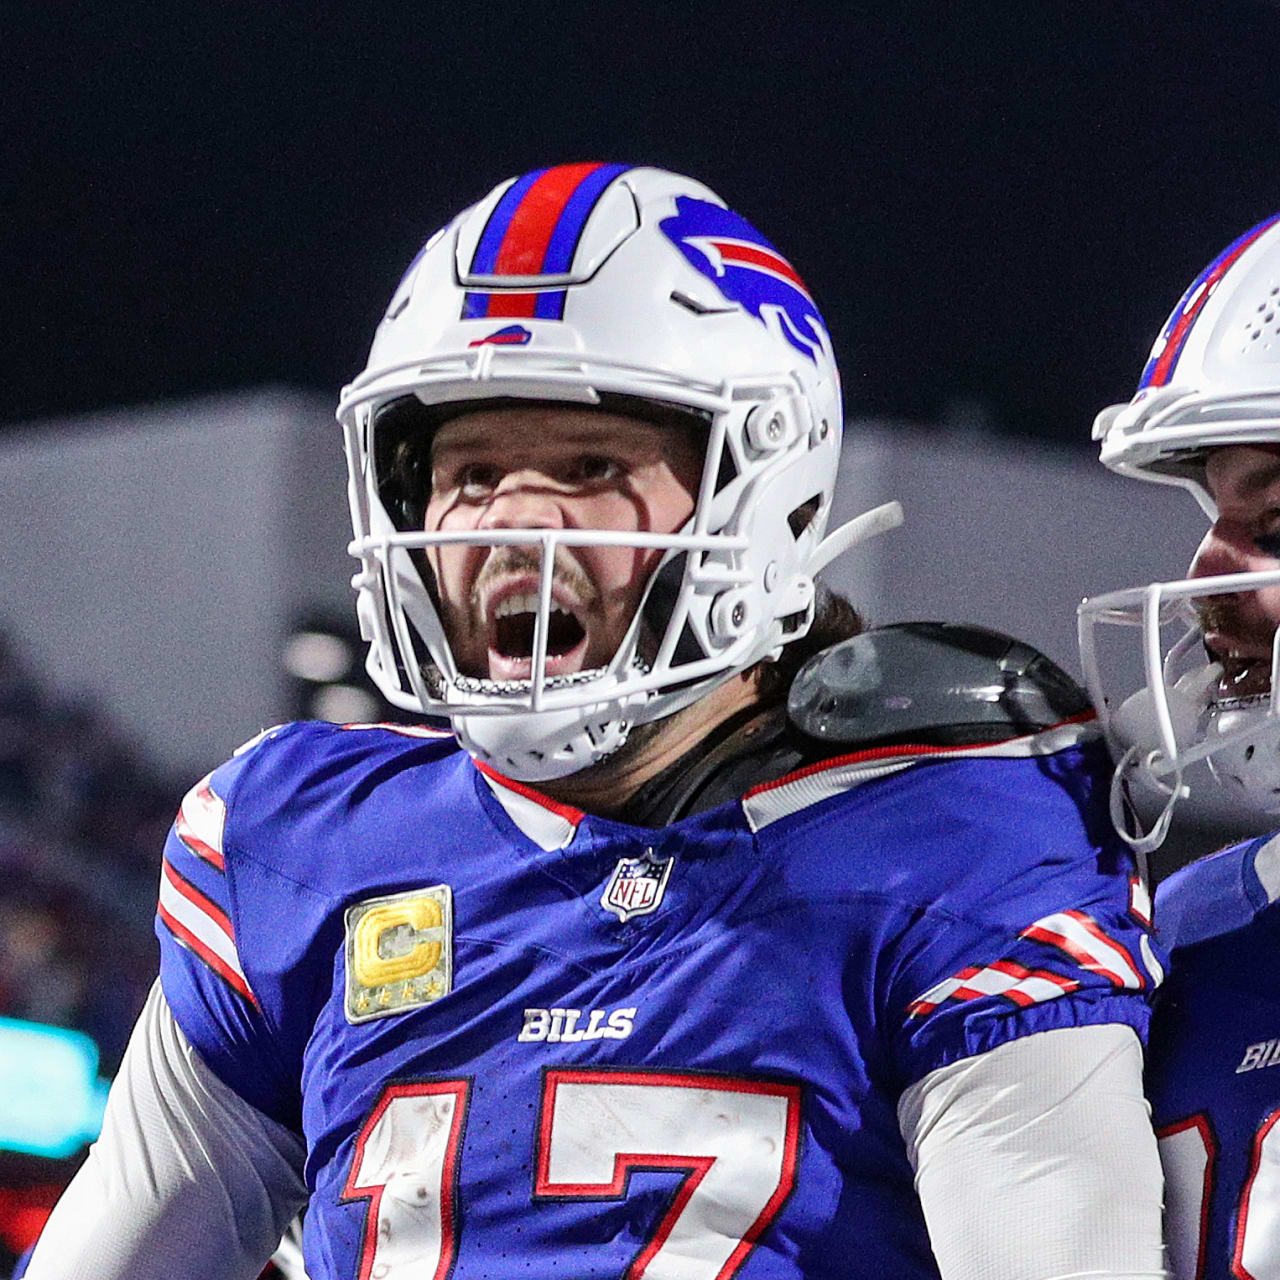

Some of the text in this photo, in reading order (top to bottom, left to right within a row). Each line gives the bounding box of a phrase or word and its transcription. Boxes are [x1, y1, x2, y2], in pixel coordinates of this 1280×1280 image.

[613, 881, 651, 907] NFL
[354, 895, 444, 988] C
[518, 1007, 637, 1042] BILLS
